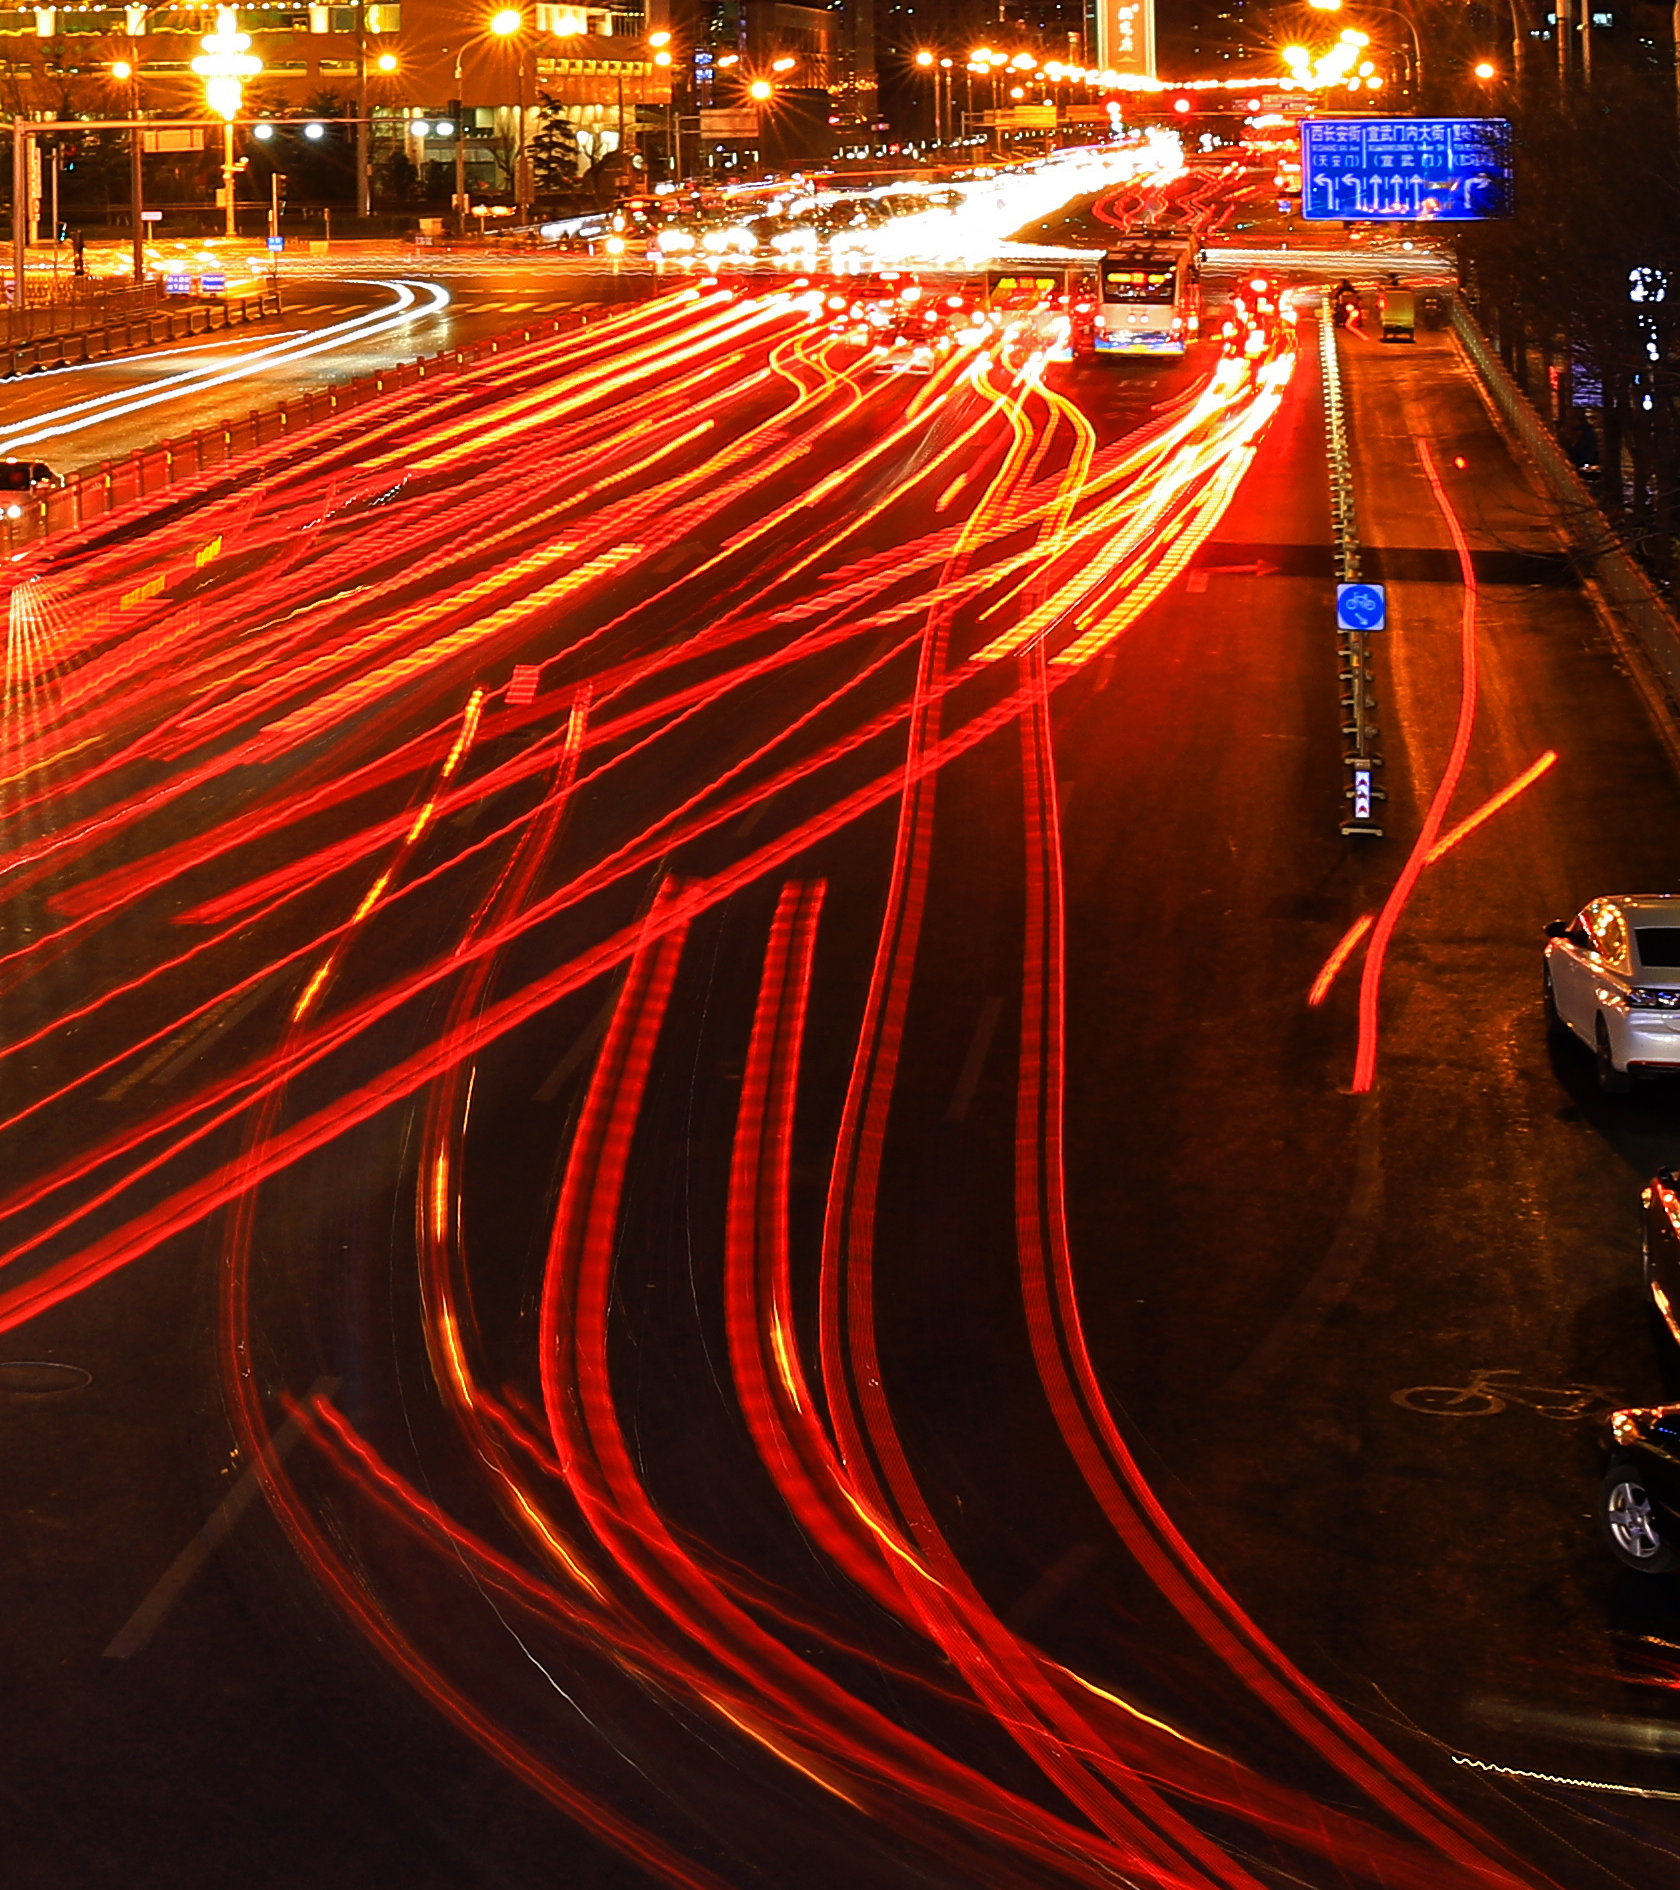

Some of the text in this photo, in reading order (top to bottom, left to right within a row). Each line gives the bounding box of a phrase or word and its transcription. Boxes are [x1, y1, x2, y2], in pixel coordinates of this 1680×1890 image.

[1310, 124, 1361, 142] 西长安街
[1367, 124, 1445, 142] 宣武门内大街
